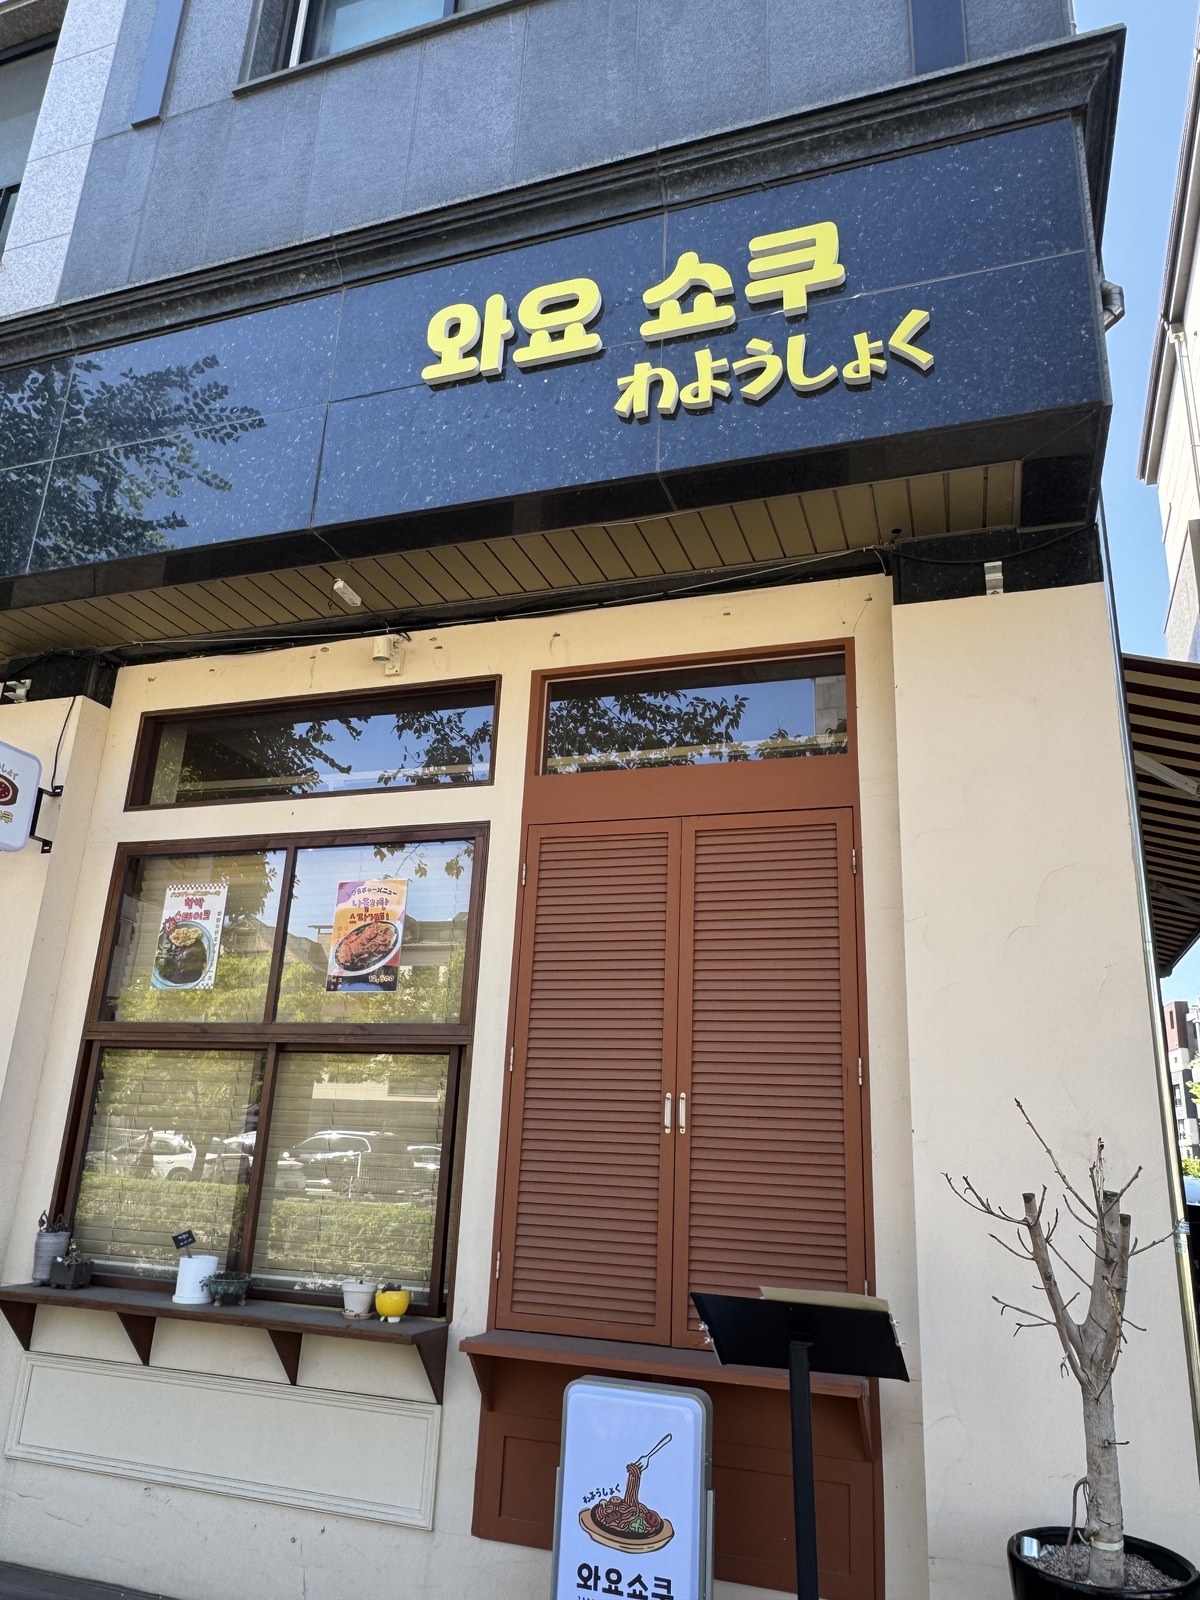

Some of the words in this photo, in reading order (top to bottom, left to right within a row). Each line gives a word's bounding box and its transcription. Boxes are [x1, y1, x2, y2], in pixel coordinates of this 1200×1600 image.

[421, 277, 603, 385] 와요
[640, 222, 845, 342] 쇼쿠
[613, 308, 935, 419] わようしょく
[582, 1483, 621, 1504] わようしょく
[576, 1562, 675, 1600] 와요쇼쿠
